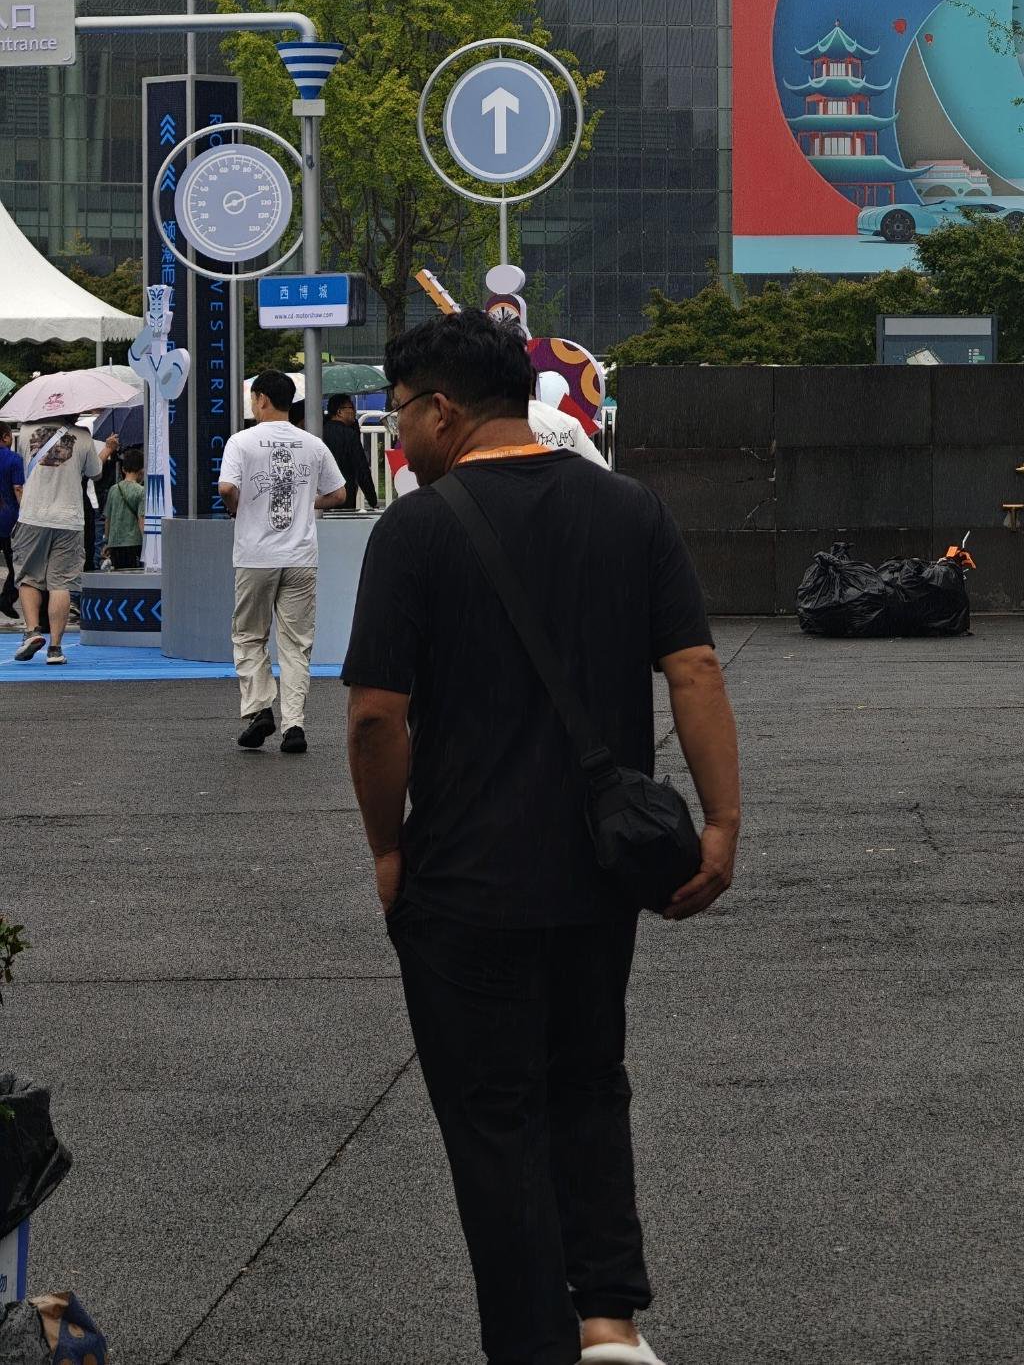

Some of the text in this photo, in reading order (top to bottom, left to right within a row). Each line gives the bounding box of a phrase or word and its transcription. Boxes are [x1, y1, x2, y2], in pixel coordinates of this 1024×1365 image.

[0, 4, 35, 30] 口
[279, 283, 328, 300] 西博城
[211, 435, 225, 520] CHIN
